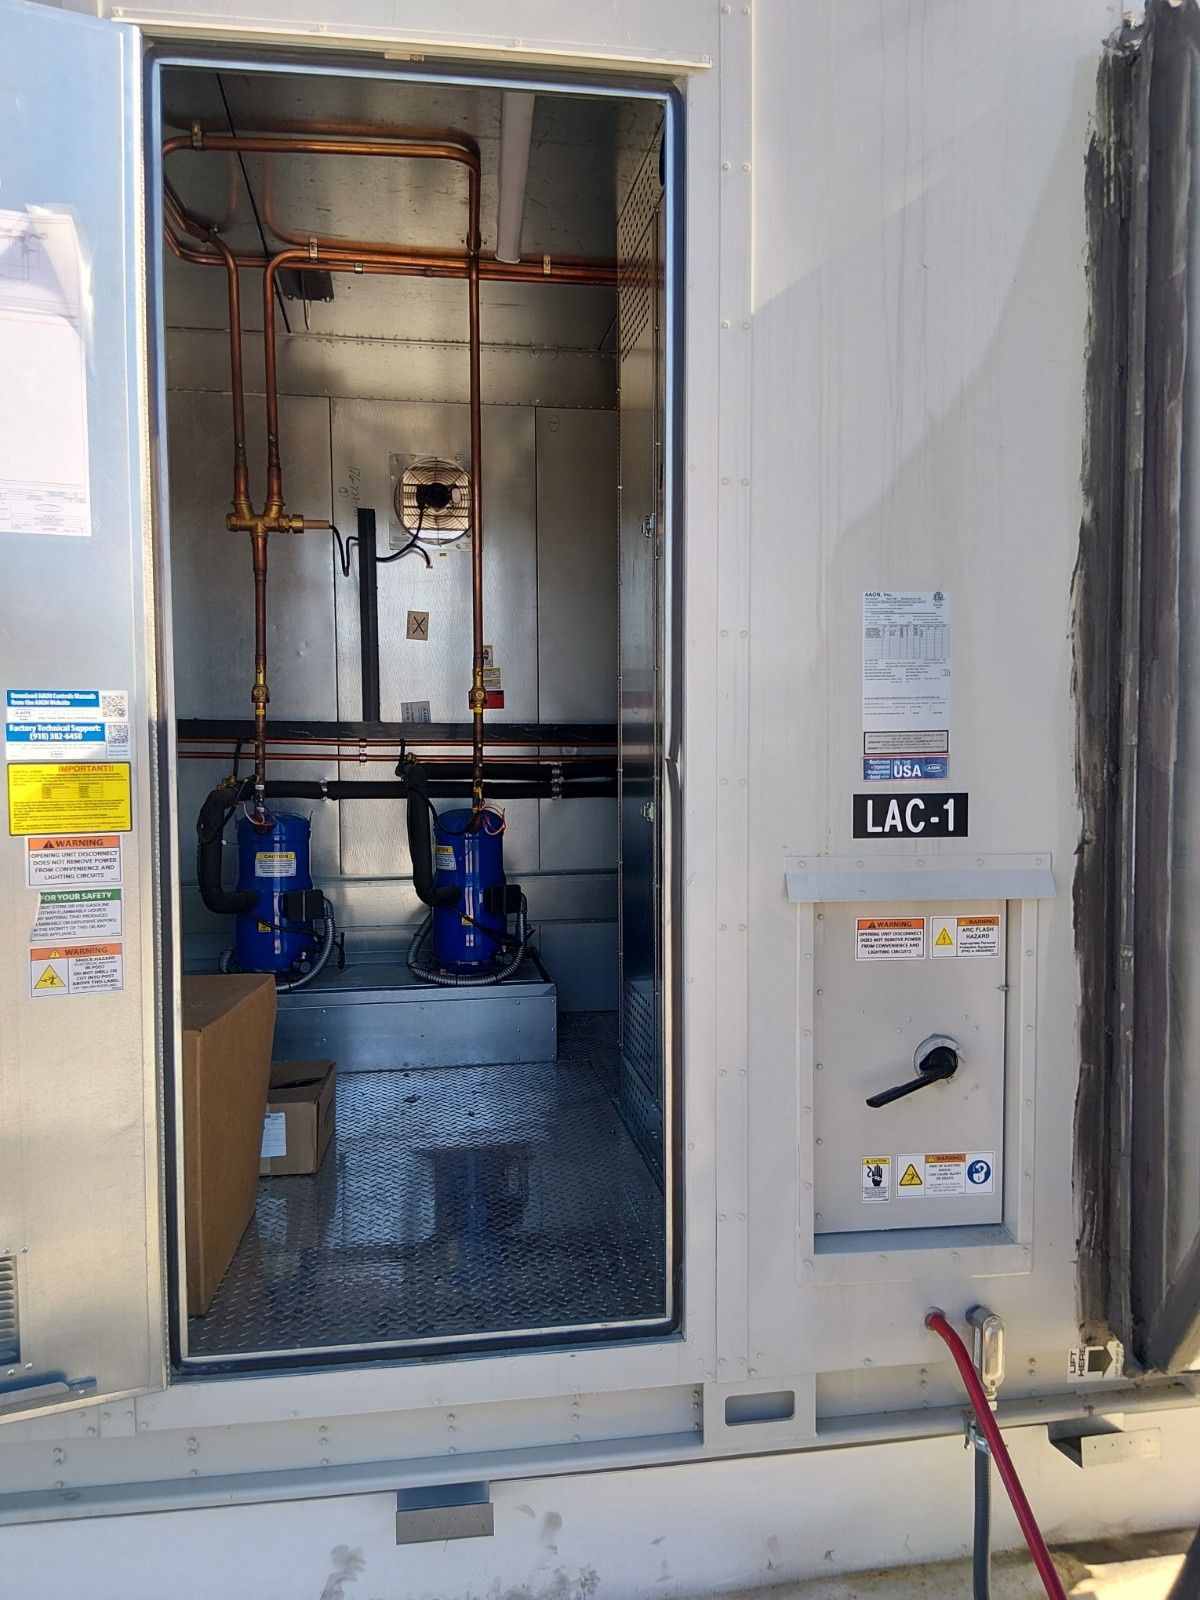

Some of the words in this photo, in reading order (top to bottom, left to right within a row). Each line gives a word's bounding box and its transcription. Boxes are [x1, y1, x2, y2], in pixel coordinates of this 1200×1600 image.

[9, 724, 36, 732] Factory
[70, 724, 102, 733] Support:
[30, 732, 48, 740] (918)
[894, 764, 922, 778] USA
[867, 798, 954, 833] LAC-1
[56, 839, 104, 848] WARNING
[82, 892, 112, 900] SAFETY
[65, 947, 108, 956] WARNING
[1078, 1344, 1086, 1376] HERE
